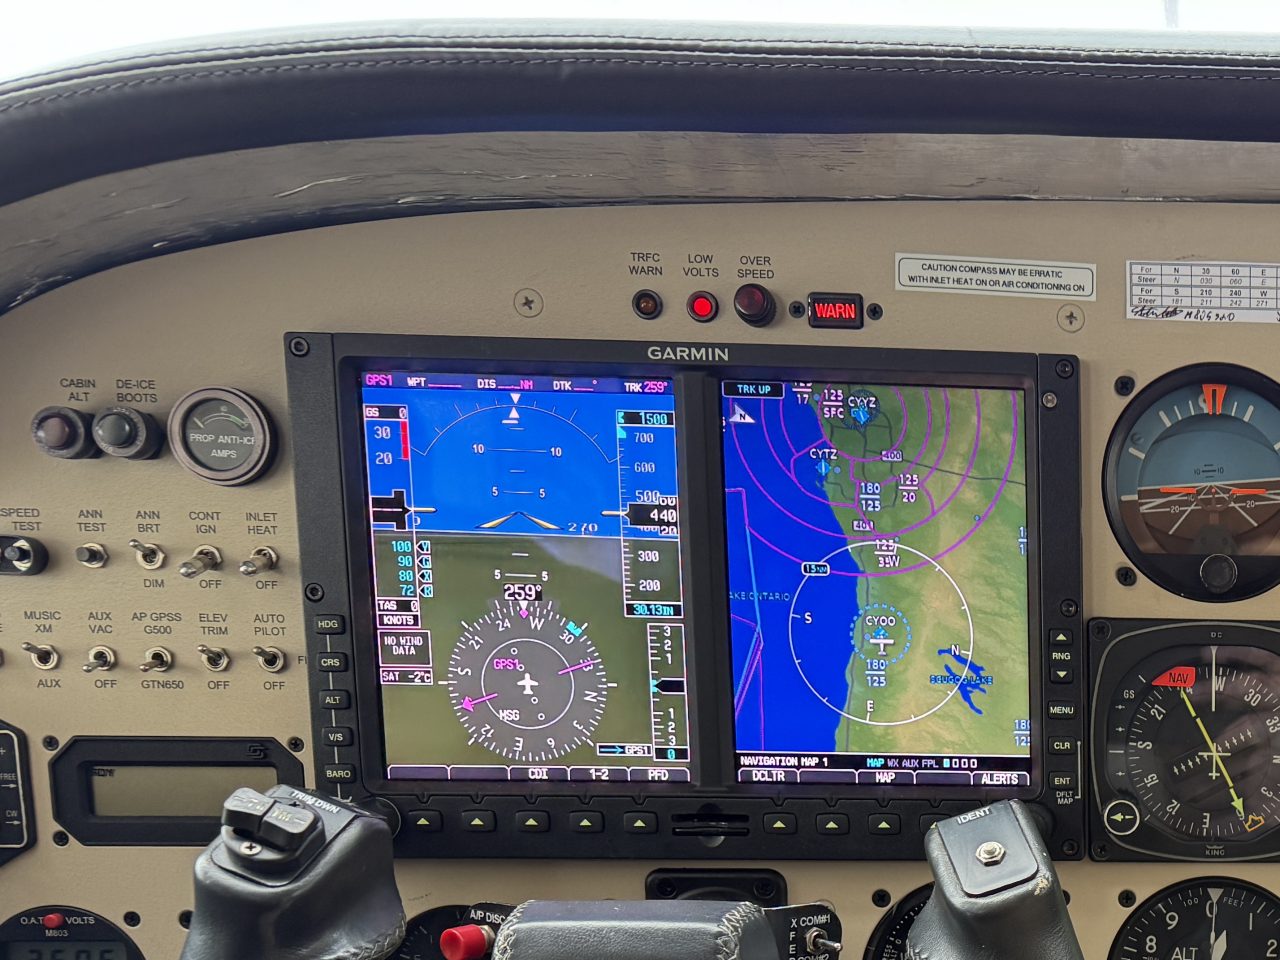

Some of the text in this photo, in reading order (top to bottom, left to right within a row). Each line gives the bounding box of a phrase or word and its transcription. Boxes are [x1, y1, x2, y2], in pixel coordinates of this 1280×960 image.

[631, 253, 660, 263] TRFC
[688, 254, 713, 264] LOW
[740, 255, 771, 266] OVER
[629, 265, 663, 276] WARN
[683, 267, 719, 278] VOLTS
[737, 268, 774, 279] SPEED
[921, 263, 1062, 279] CAUTION COMPASS MAY BE ERRATIC
[908, 275, 928, 283] WITH
[930, 276, 951, 285] INLET
[953, 277, 974, 286] HEAT
[1016, 281, 1071, 292] CONDITIONING
[1073, 284, 1085, 292] ON
[815, 303, 855, 319] WARN
[647, 346, 728, 361] GARMIN
[60, 378, 96, 388] CABIN
[116, 380, 156, 390] DE-ICE
[365, 374, 393, 387] GPS1
[624, 381, 668, 393] TRK 259°
[737, 385, 771, 395] TRK UP
[69, 392, 89, 402] ALT
[117, 392, 158, 403] BOOTS
[639, 413, 668, 425] 1500
[810, 449, 837, 459] CYTZ
[79, 510, 103, 519] ANN
[246, 513, 277, 522] INLET
[77, 523, 106, 532] TEST
[248, 525, 277, 535] HEAT
[24, 611, 61, 621] MUSIC
[88, 612, 112, 621] AUX
[132, 612, 182, 622] AP GPSS
[199, 614, 228, 623] ELEV
[254, 614, 285, 624] AUTO
[383, 615, 414, 625] KNOTS
[36, 624, 52, 633] XM
[89, 625, 112, 634] VAC
[318, 620, 338, 629] HDG
[144, 625, 172, 635] G500
[201, 626, 228, 635] TRIM
[254, 627, 286, 636] PILOT
[1053, 652, 1071, 660] RNG
[321, 658, 340, 667] CRS
[1168, 672, 1189, 684] NAV
[141, 680, 184, 690] GTN650
[325, 696, 340, 704] ALT
[1050, 706, 1074, 715] MENU
[1054, 741, 1070, 750] CLR
[741, 757, 829, 767] NAVIGATION MAP 1
[326, 770, 350, 778] BARO
[528, 769, 549, 780] CDI
[648, 769, 669, 780] PFD
[752, 771, 785, 782] DCLTR
[982, 773, 1018, 784] ALERTS
[1054, 777, 1070, 785] ENT
[956, 807, 991, 825] IDENT
[1171, 947, 1198, 960] ALT
